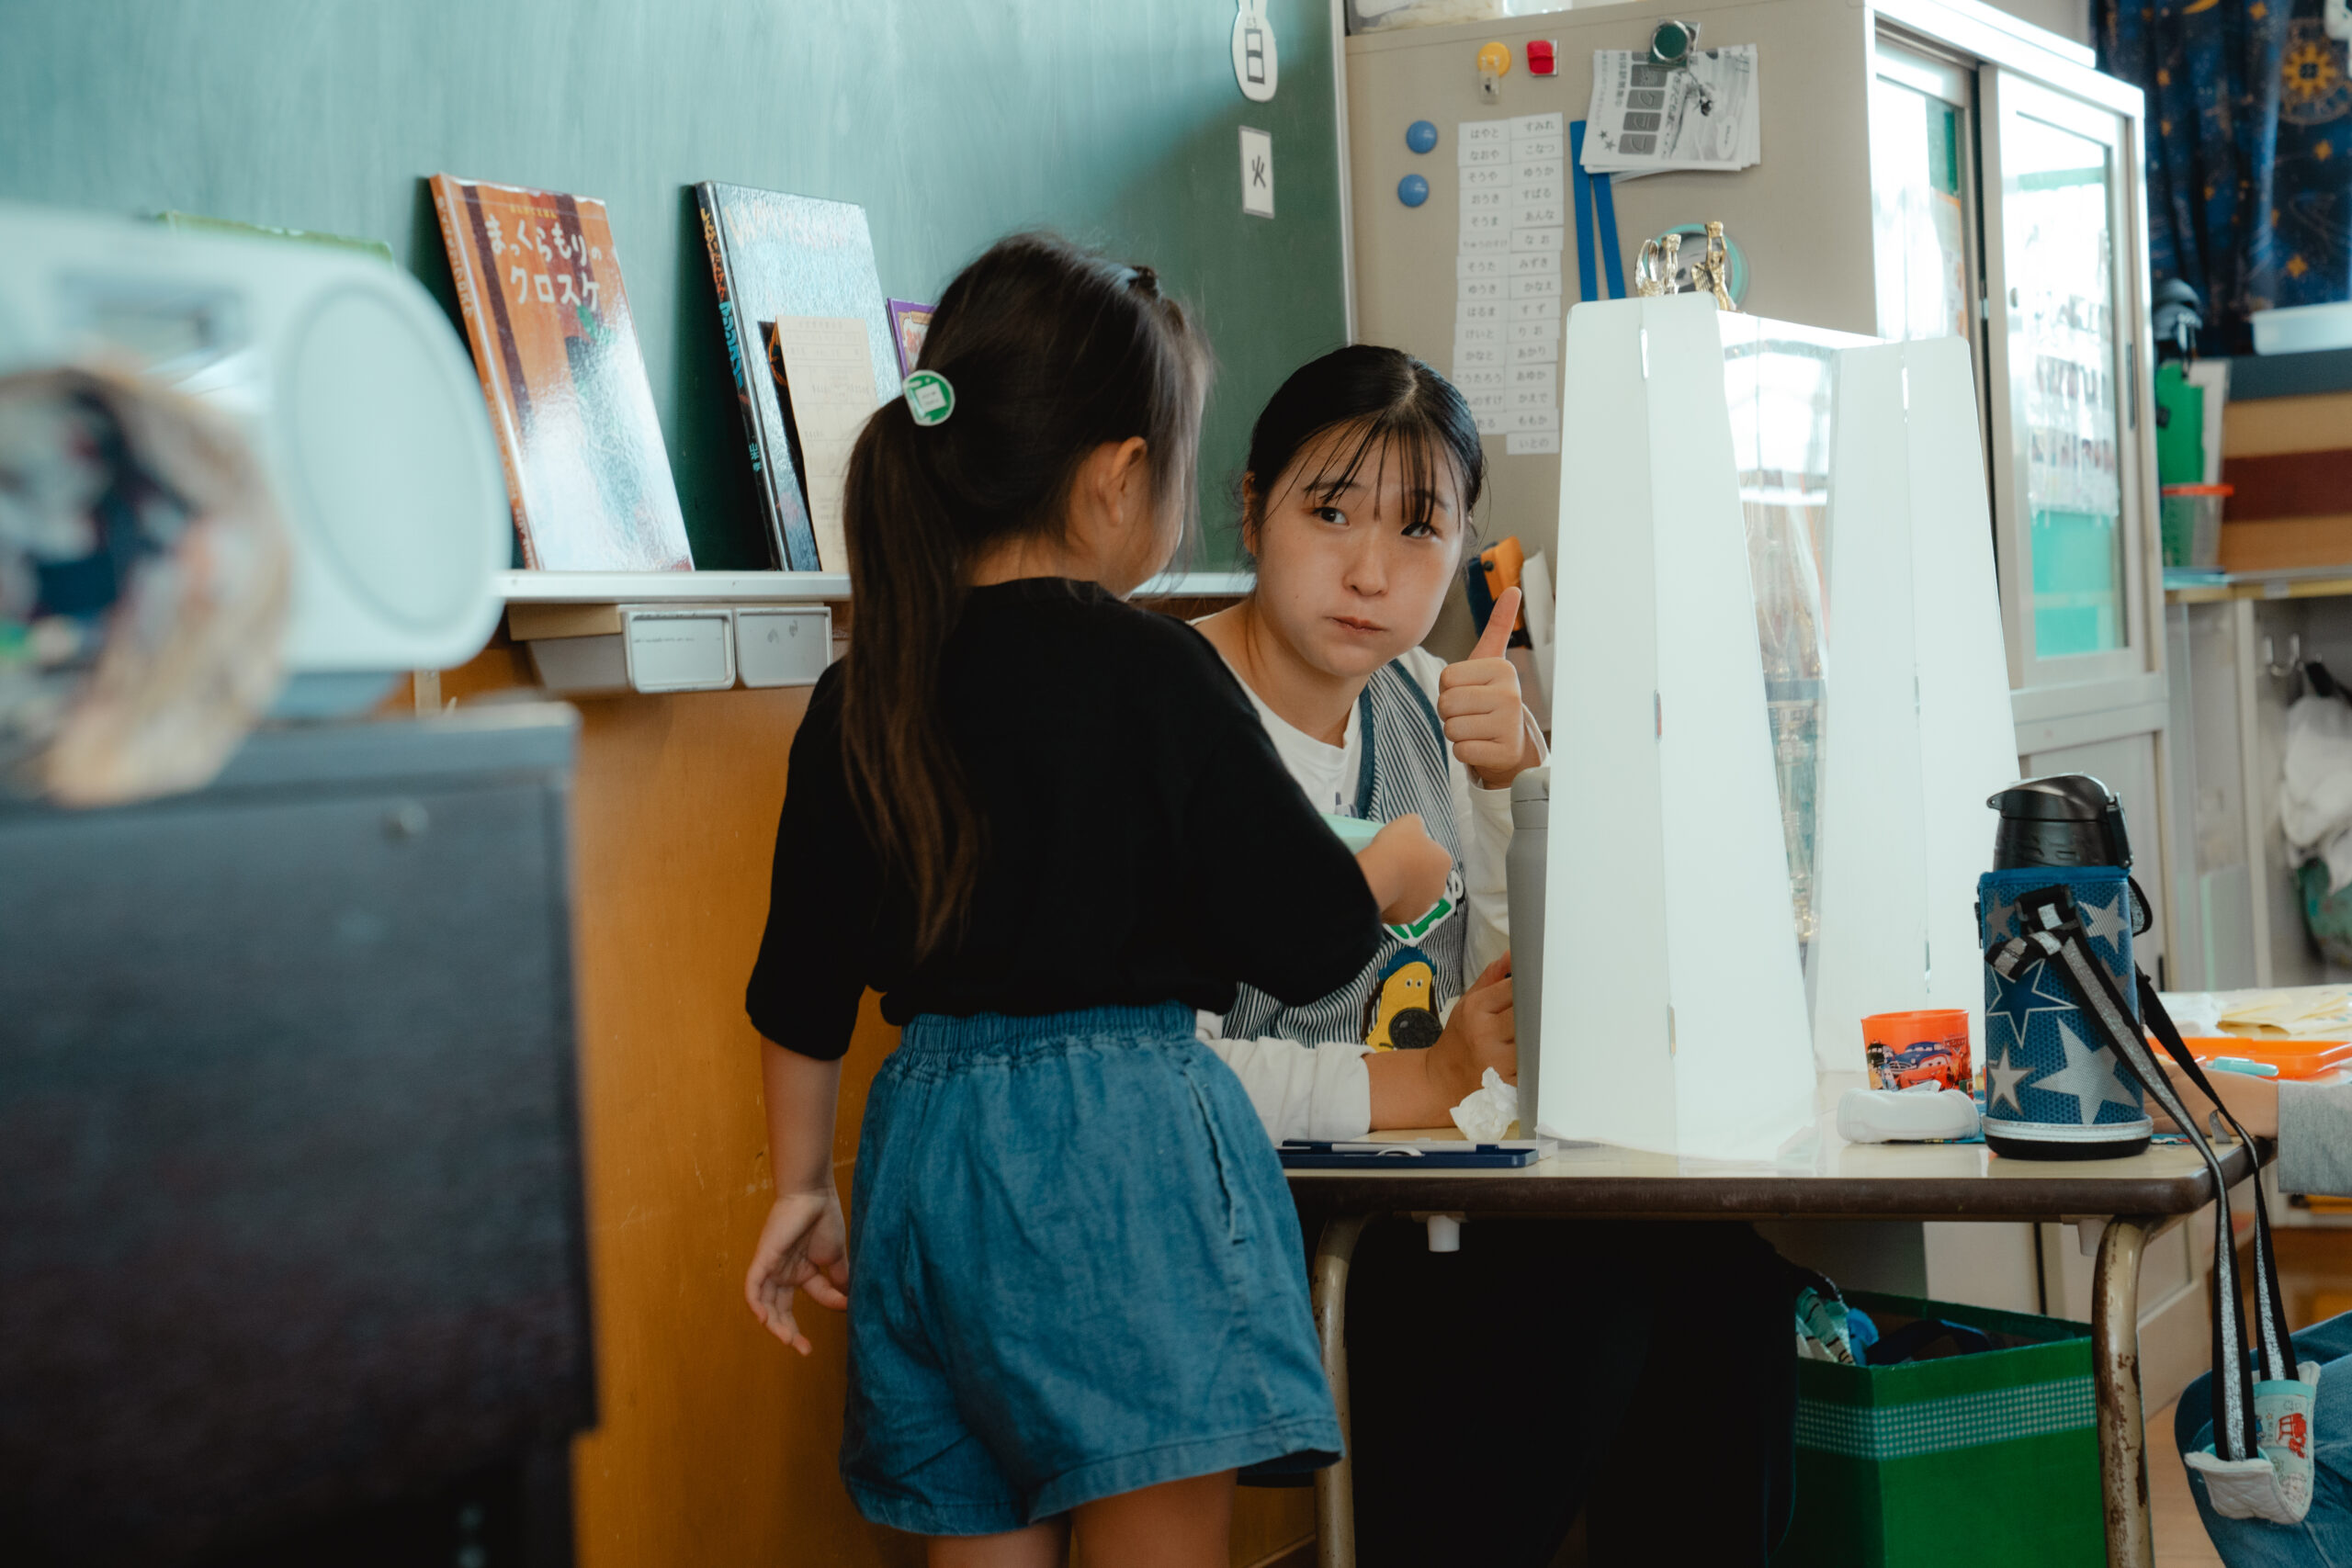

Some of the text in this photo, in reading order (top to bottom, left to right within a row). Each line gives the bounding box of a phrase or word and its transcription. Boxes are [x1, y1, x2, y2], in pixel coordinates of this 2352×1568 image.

[1245, 28, 1265, 85] 日
[1470, 128, 1499, 139] はやと
[1525, 143, 1555, 155] こなつ
[1251, 154, 1267, 189] 火
[1468, 171, 1498, 183] そうや
[484, 213, 603, 267] まっくらもりの
[511, 265, 600, 311] クロスケ
